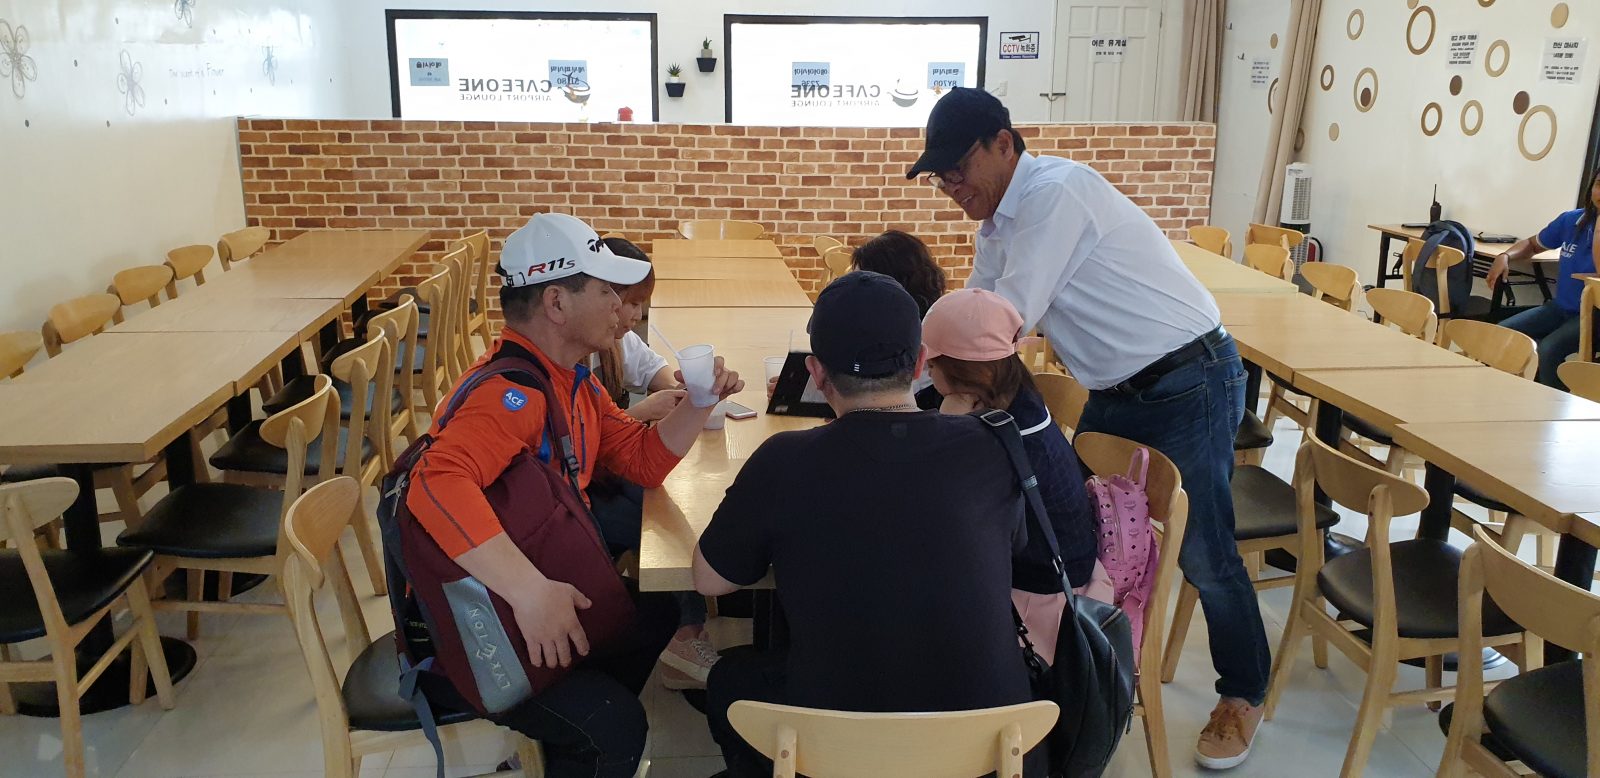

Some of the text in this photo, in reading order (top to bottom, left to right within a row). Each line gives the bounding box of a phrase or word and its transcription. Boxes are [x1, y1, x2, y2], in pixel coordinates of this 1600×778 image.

[1003, 43, 1036, 53] CCTV 녹화중
[505, 391, 525, 406] ACE
